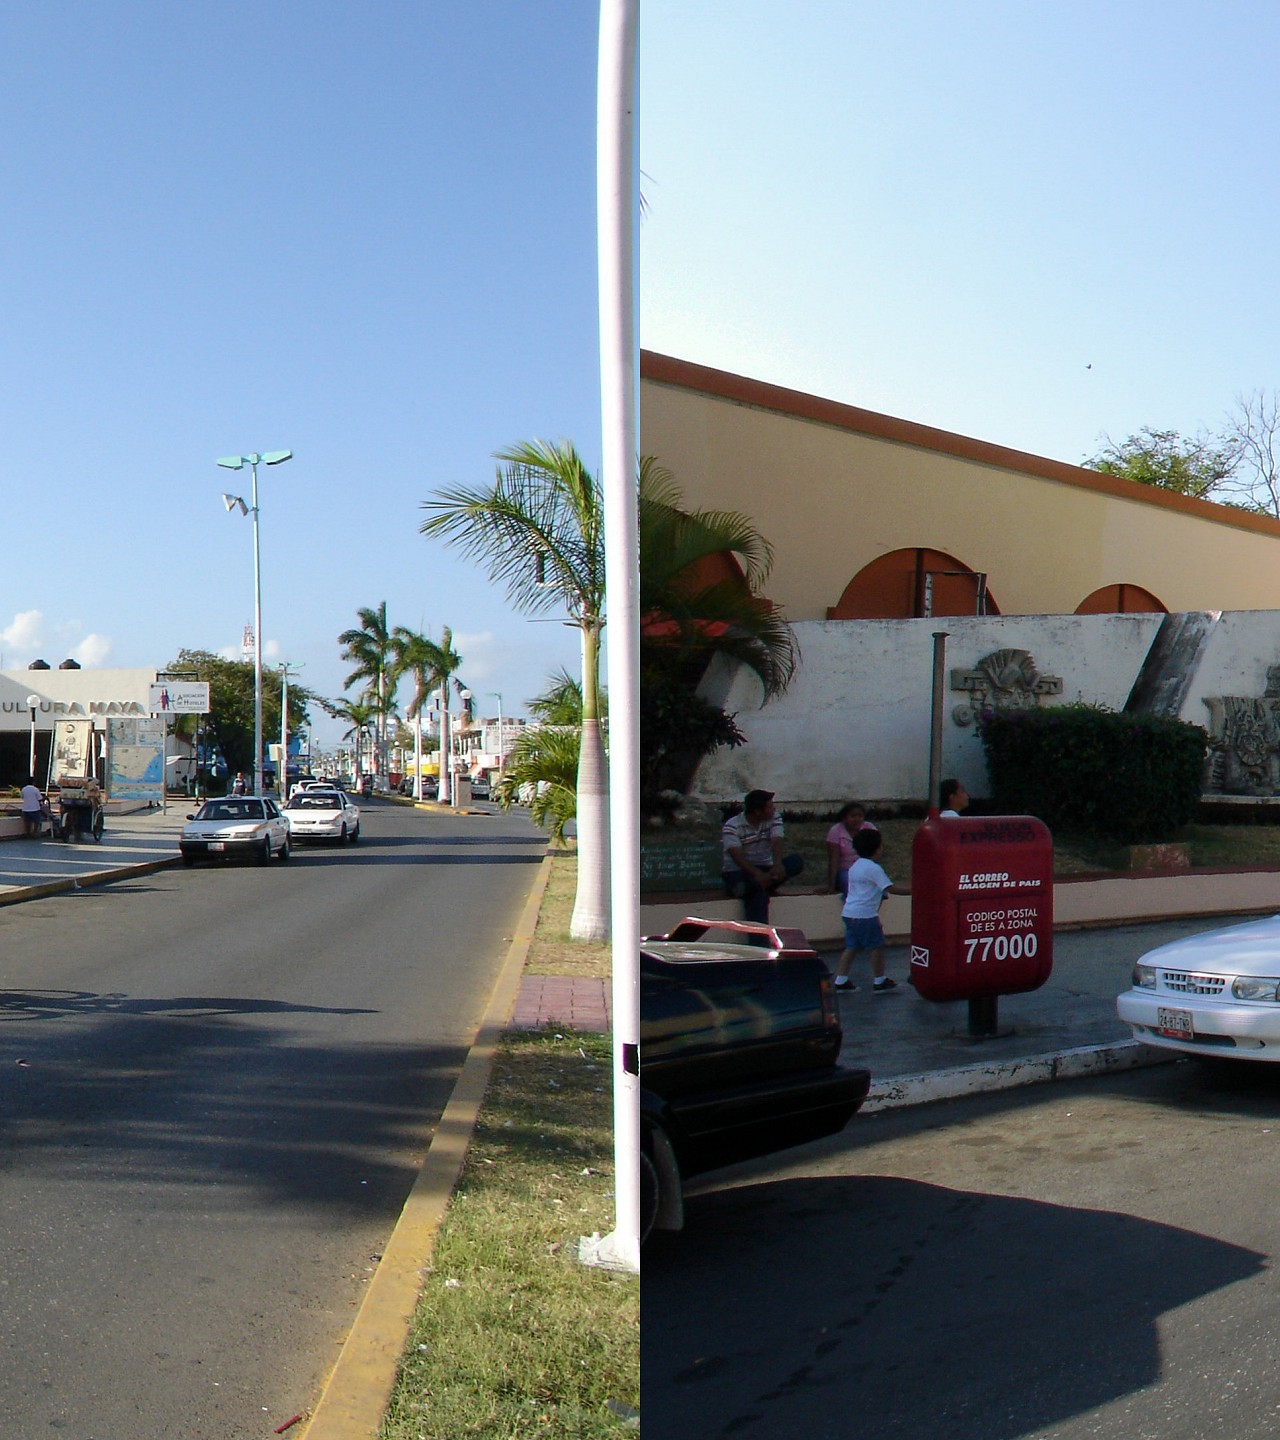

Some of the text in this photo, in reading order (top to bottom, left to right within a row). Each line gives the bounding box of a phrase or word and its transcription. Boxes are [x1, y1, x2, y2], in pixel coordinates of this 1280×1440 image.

[89, 701, 140, 714] MAYA
[960, 831, 1036, 844] EXPRESSO
[959, 872, 1009, 883] EL CORREO
[958, 881, 1001, 890] IMAGEN
[1018, 879, 1041, 887] PAIS
[966, 908, 1038, 922] CODIGO POSTAL
[970, 923, 983, 933] DE
[1007, 919, 1034, 929] ZONA
[964, 933, 1038, 963] 77000
